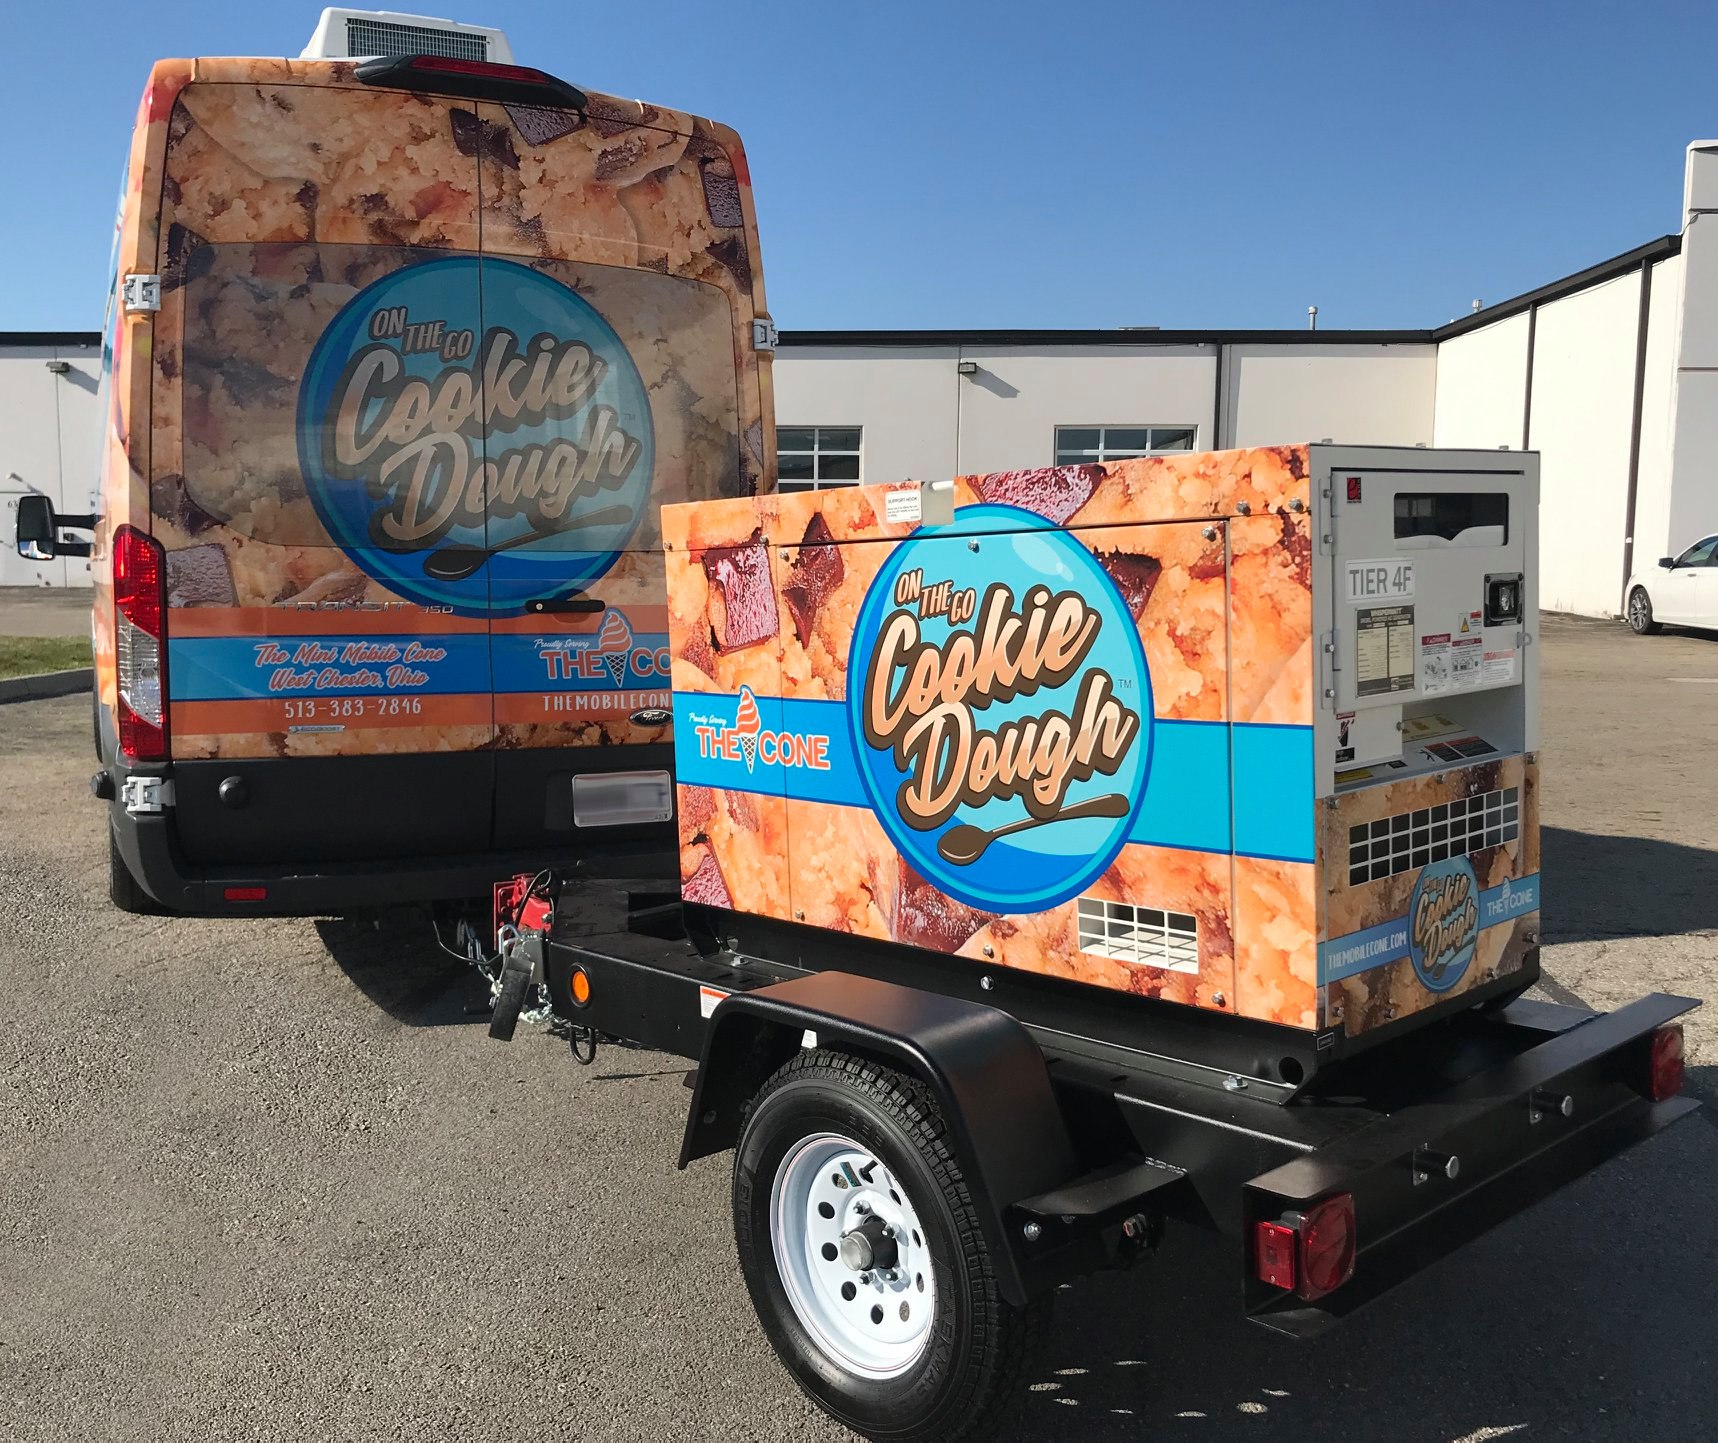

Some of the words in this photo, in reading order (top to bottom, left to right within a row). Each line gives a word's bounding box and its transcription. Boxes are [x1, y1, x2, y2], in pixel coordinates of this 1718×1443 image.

[373, 306, 407, 338] ON
[404, 321, 447, 352] THE
[441, 329, 473, 360] GO
[332, 328, 606, 468] Cookie
[377, 407, 640, 543] Dough
[896, 568, 923, 604] ON
[919, 580, 954, 618] THE
[949, 587, 977, 624] GO
[1349, 567, 1388, 596] TIER
[1392, 565, 1412, 593] 4F
[271, 600, 416, 613] TRANSIT
[254, 642, 290, 667] The
[292, 641, 338, 666] Mini
[340, 640, 401, 666] Mobile
[403, 641, 447, 663] Cone
[534, 638, 563, 649] Proudly
[565, 638, 590, 649] Serving
[269, 667, 318, 691] West
[386, 664, 430, 689] Ohio
[538, 648, 608, 680] THE
[868, 586, 1098, 739] Cookie
[284, 697, 422, 719] 513-383-2846
[542, 693, 669, 711] THEMOBILECON
[688, 712, 708, 725] Proudly
[694, 725, 742, 761] THE
[758, 729, 831, 770] CONE
[900, 672, 1135, 819] Dough
[1414, 873, 1471, 944] Cookie
[1487, 898, 1505, 917] THE
[1509, 887, 1534, 909] CONE
[1327, 930, 1407, 970] THEMOBILECONE.COM
[1422, 896, 1478, 969] Dough
